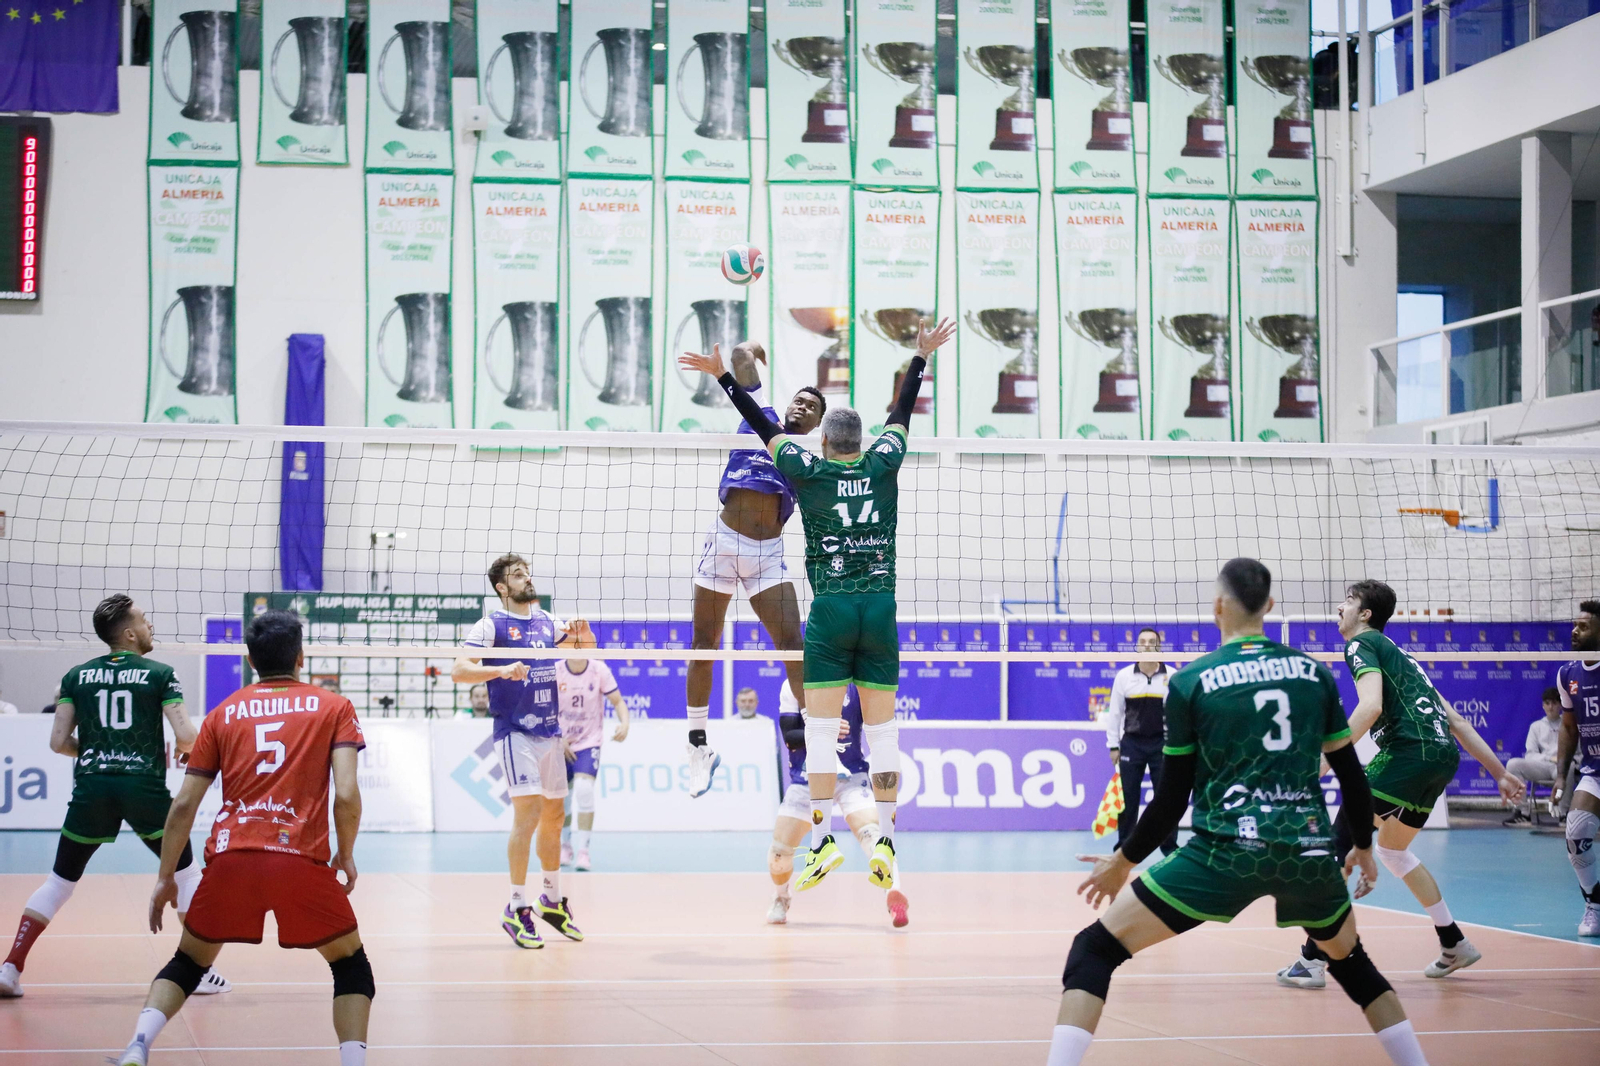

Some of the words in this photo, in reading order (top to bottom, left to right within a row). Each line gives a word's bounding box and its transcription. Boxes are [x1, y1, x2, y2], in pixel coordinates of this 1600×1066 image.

[191, 142, 222, 152] Unicaja
[300, 145, 331, 154] Unicaja
[406, 151, 437, 160] Unicaja
[607, 156, 637, 166] Unicaja
[514, 160, 545, 169] Unicaja
[704, 159, 734, 169] Unicaja
[807, 163, 837, 171] Unicaja
[894, 167, 922, 177] Unicaja
[994, 170, 1023, 179] Unicaja
[1091, 170, 1120, 179] Unicaja
[165, 174, 221, 185] UNICAJA
[1185, 177, 1214, 186] Unicaja
[1273, 178, 1301, 187] Unicaja
[381, 182, 437, 193] UNICAJA
[582, 187, 637, 198] UNICAJA
[488, 191, 544, 202] UNICAJA
[680, 189, 735, 201] UNICAJA
[784, 192, 836, 201] UNICAJA
[869, 199, 923, 210] UNICAJA
[970, 200, 1023, 210] UNICAJA
[1069, 201, 1121, 211] UNICAJA
[1163, 206, 1215, 217] UNICAJA
[1250, 207, 1302, 218] UNICAJA
[837, 477, 873, 497] RUIZ
[832, 500, 879, 527] 14
[315, 596, 390, 609] SUPERLIGA
[394, 597, 413, 609] DE
[418, 597, 480, 610] VOLEIBOL
[78, 668, 114, 685] FRAN
[117, 669, 151, 685] RUIZ
[1199, 655, 1320, 694] RODRÍGUEZ
[572, 694, 584, 708] 21
[1583, 696, 1600, 717] 15
[94, 689, 133, 730] 10
[224, 696, 319, 724] PAQUILLO
[1253, 689, 1292, 751] 3
[255, 721, 286, 775] 5
[96, 750, 145, 763] Andalucía
[236, 795, 298, 818] Andalucía
